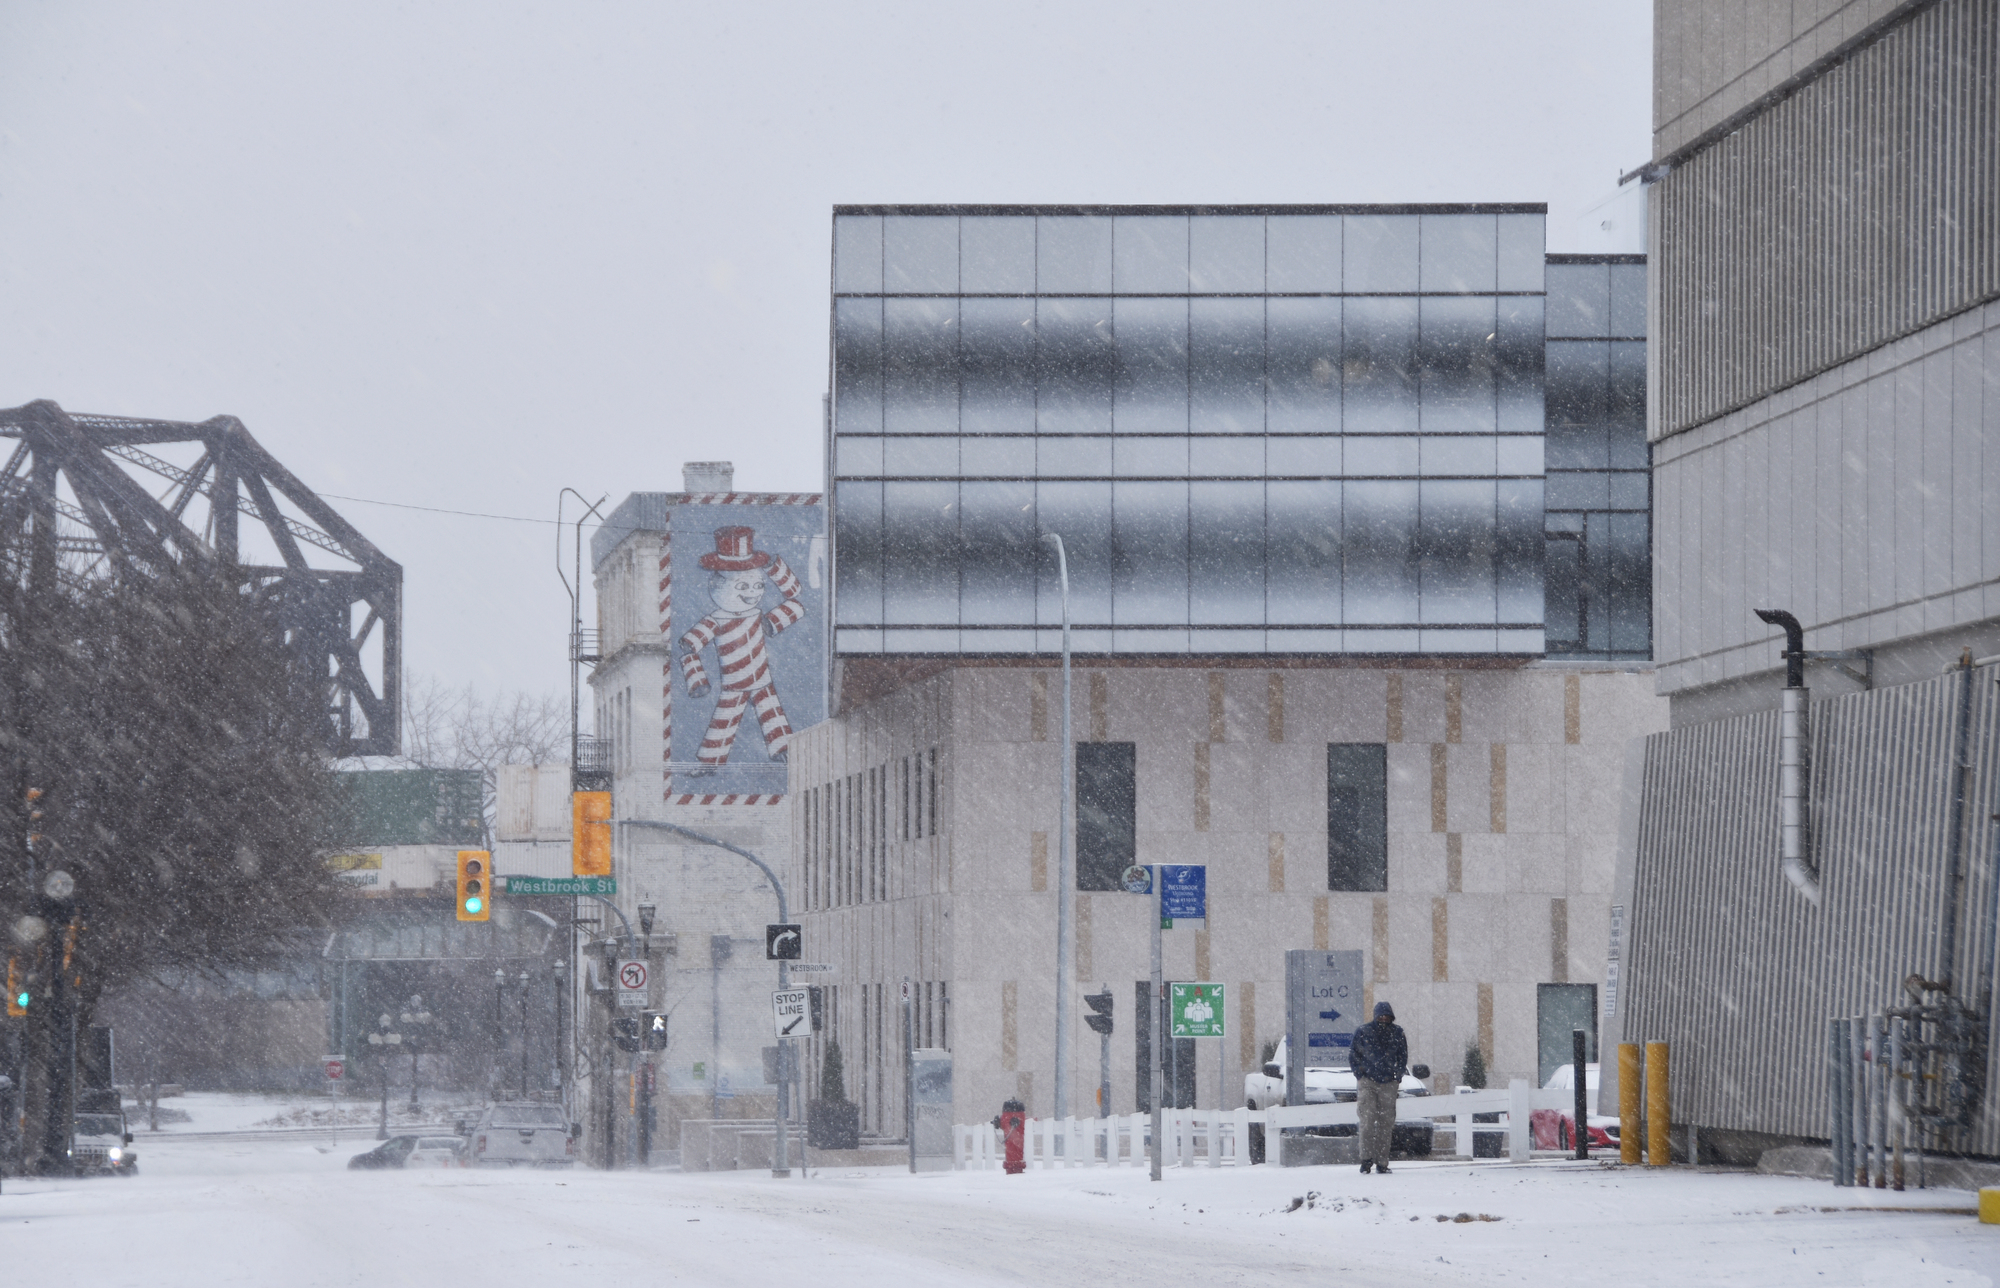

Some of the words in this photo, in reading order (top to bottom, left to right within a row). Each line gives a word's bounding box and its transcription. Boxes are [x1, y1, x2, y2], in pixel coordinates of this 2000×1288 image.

[510, 880, 590, 892] Westbrook
[597, 880, 612, 892] St
[789, 964, 828, 972] WESTBROOK
[1194, 986, 1203, 997] A
[1312, 985, 1334, 998] Lot
[1337, 985, 1349, 998] C
[775, 993, 805, 1004] STOP
[778, 1004, 804, 1015] LINE
